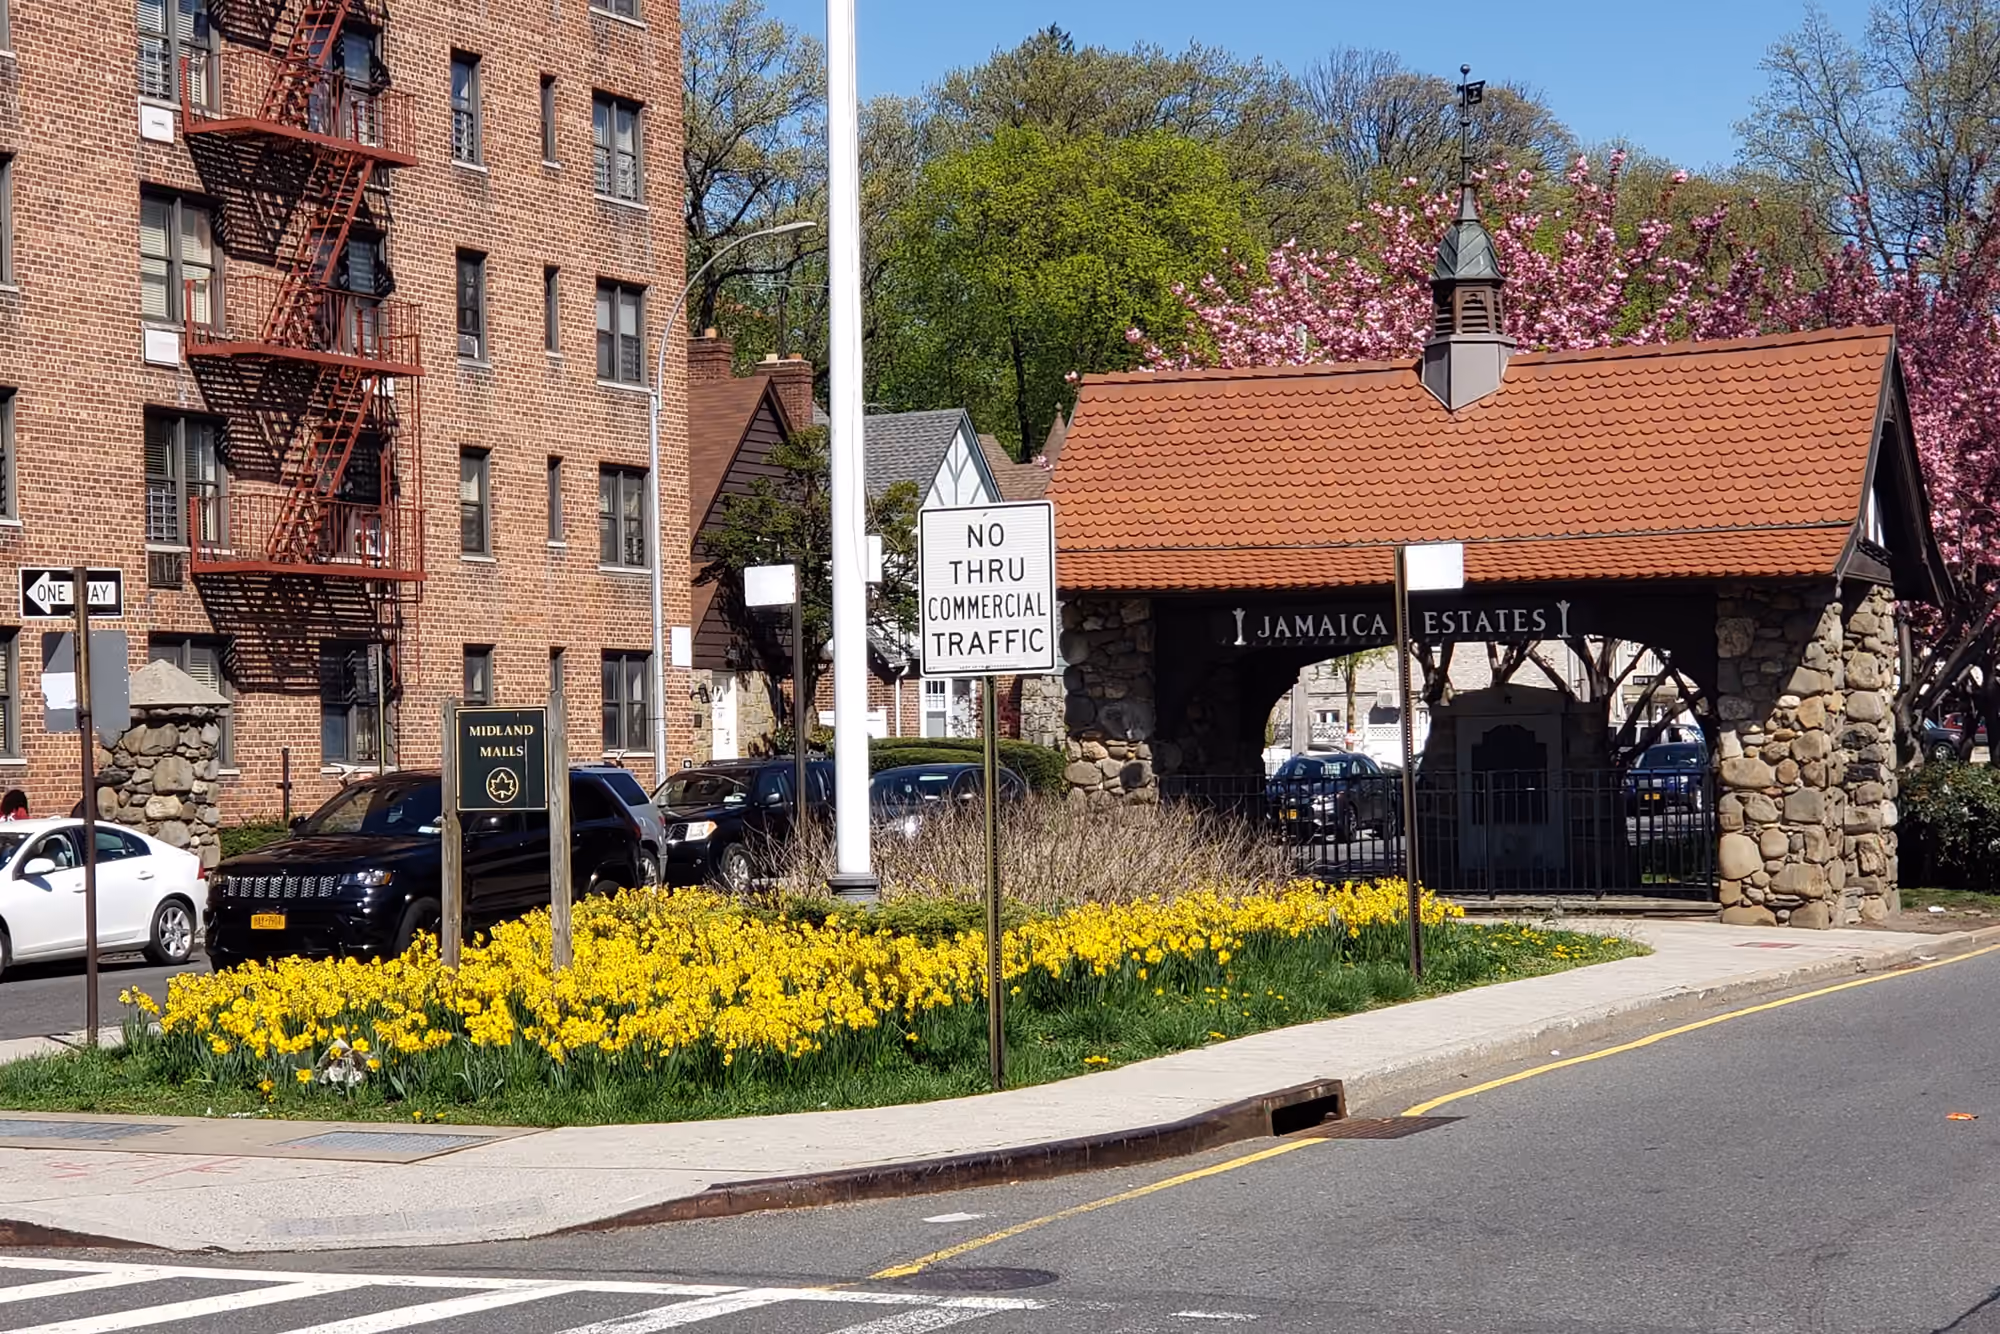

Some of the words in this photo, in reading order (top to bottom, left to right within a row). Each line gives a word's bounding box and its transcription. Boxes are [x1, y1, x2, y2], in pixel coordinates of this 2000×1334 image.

[967, 523, 1004, 548] NO
[949, 557, 1024, 584] THRU
[37, 584, 65, 602] ONE
[85, 584, 110, 602] AY
[928, 592, 1046, 621] COMMERCIAL
[1257, 613, 1389, 638] JAMAICA
[1422, 608, 1547, 635] ESTATES
[931, 628, 1044, 656] TRAFFIC
[469, 724, 534, 737] MIDLAND
[480, 745, 524, 757] MALLS
